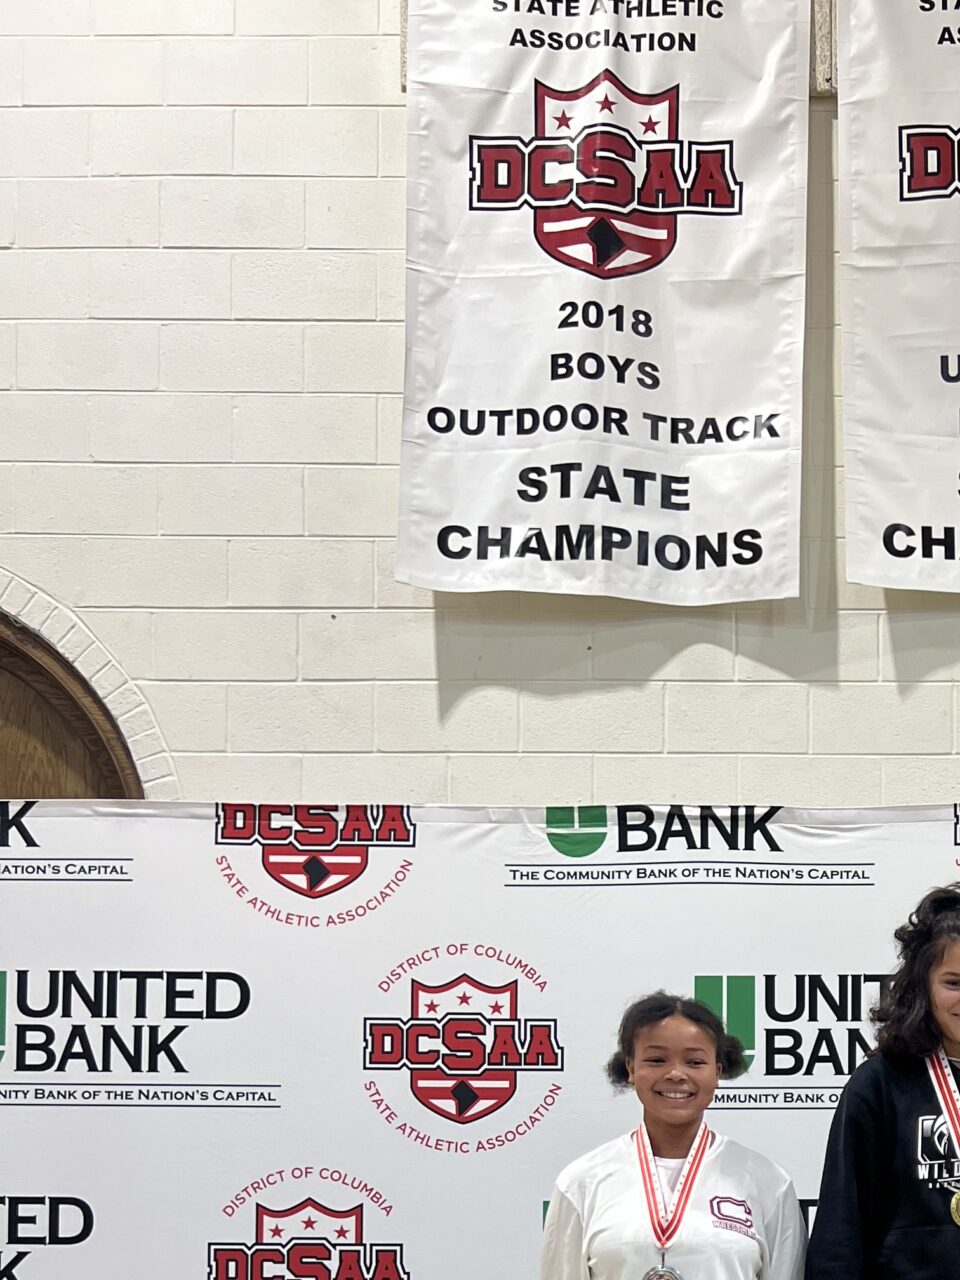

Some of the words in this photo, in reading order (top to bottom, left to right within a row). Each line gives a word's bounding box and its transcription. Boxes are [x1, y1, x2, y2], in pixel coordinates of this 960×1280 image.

[493, 0, 579, 16] STATE
[590, 0, 723, 18] ATHLETIC
[510, 29, 695, 52] ASSOCIATION
[469, 124, 743, 215] DCSAA
[558, 301, 652, 337] 2018
[551, 353, 659, 389] BOYS
[428, 404, 629, 435] OUTDOOR
[643, 413, 779, 444] TRACK
[517, 463, 689, 510] STATE
[437, 525, 762, 570] CHAMPIONS
[215, 805, 416, 853] DCSAA
[615, 805, 784, 852] BANK
[216, 856, 247, 897] STATE
[248, 896, 319, 928] ATHLETIC
[325, 860, 412, 926] ASSOCIATION
[510, 870, 539, 880] THE
[544, 870, 631, 880] COMMUNITY
[637, 869, 678, 879] BANK
[682, 869, 700, 878] OF
[704, 868, 731, 878] THE
[736, 868, 803, 880] NATION'S
[808, 869, 869, 880] CAPITAL
[379, 947, 439, 992] DISTRICT
[445, 944, 467, 956] OF
[474, 944, 547, 991] COLUMBIA
[16, 970, 250, 1019] UNITED
[764, 974, 896, 1022] UNIT
[14, 1024, 188, 1072] BANK
[363, 1012, 564, 1076] DCSAA
[35, 1089, 76, 1099] BANK
[82, 1091, 101, 1099] OF
[105, 1091, 133, 1099] THE
[139, 1090, 208, 1100] NATION'S
[213, 1090, 276, 1101] CAPITAL
[365, 1082, 396, 1122] STATE
[397, 1123, 466, 1152] ATHLETIC
[476, 1084, 560, 1151] ASSOCIATION
[224, 1170, 284, 1216] DISTRICT
[291, 1167, 312, 1180] OF
[319, 1168, 393, 1215] COLUMBIA
[709, 1195, 754, 1229] C
